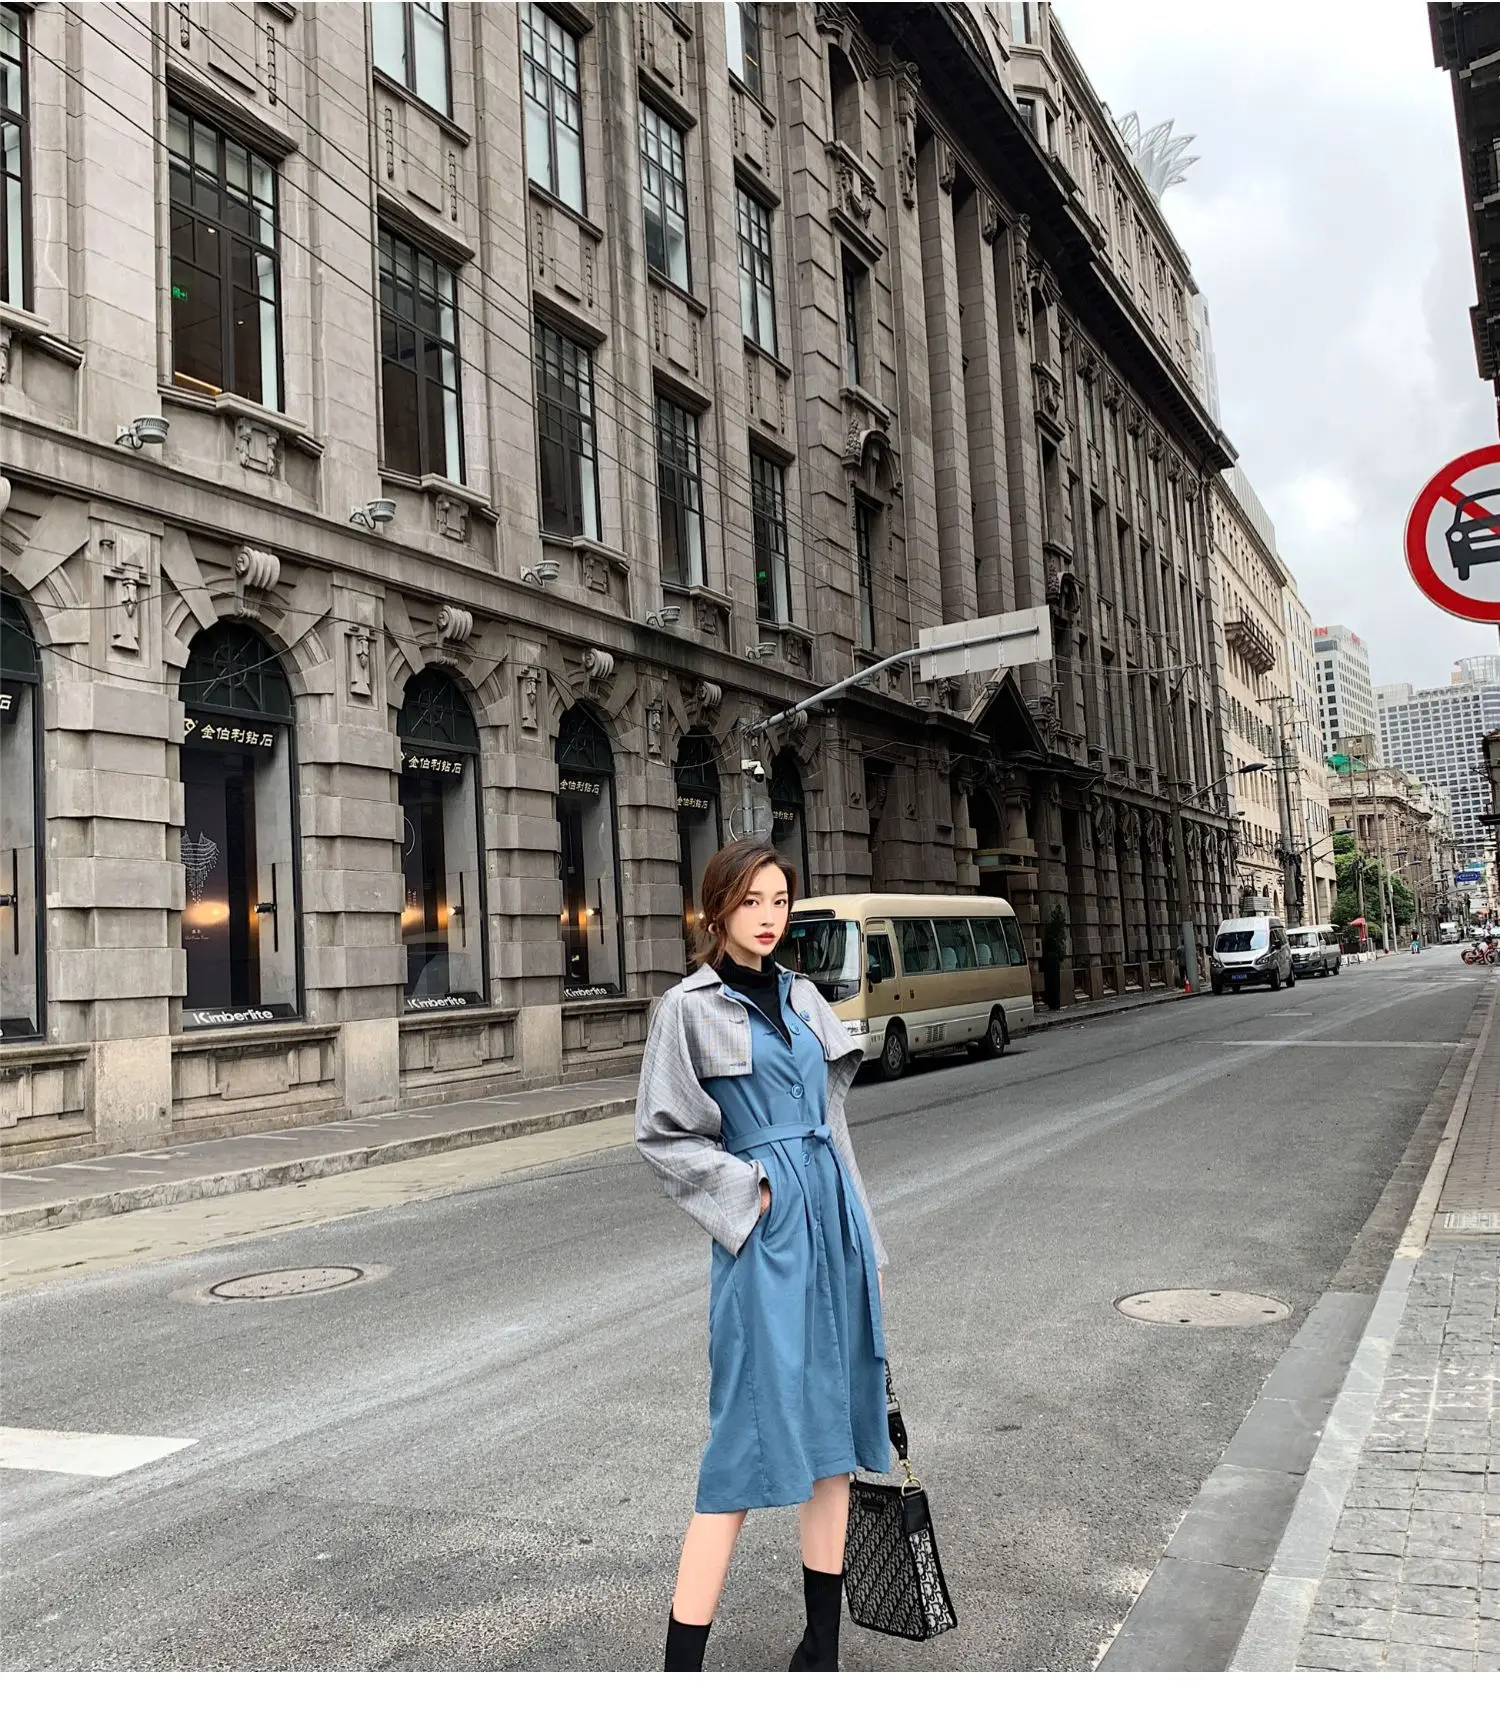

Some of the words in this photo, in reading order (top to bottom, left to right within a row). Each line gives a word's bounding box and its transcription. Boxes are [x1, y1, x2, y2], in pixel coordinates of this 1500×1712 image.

[200, 723, 274, 747] 金伯利钻石
[408, 755, 463, 774] 金伯利钻石
[563, 986, 608, 998] Kimberlite
[407, 996, 467, 1009] Kimberlite
[192, 1008, 274, 1025] Kimberlite
